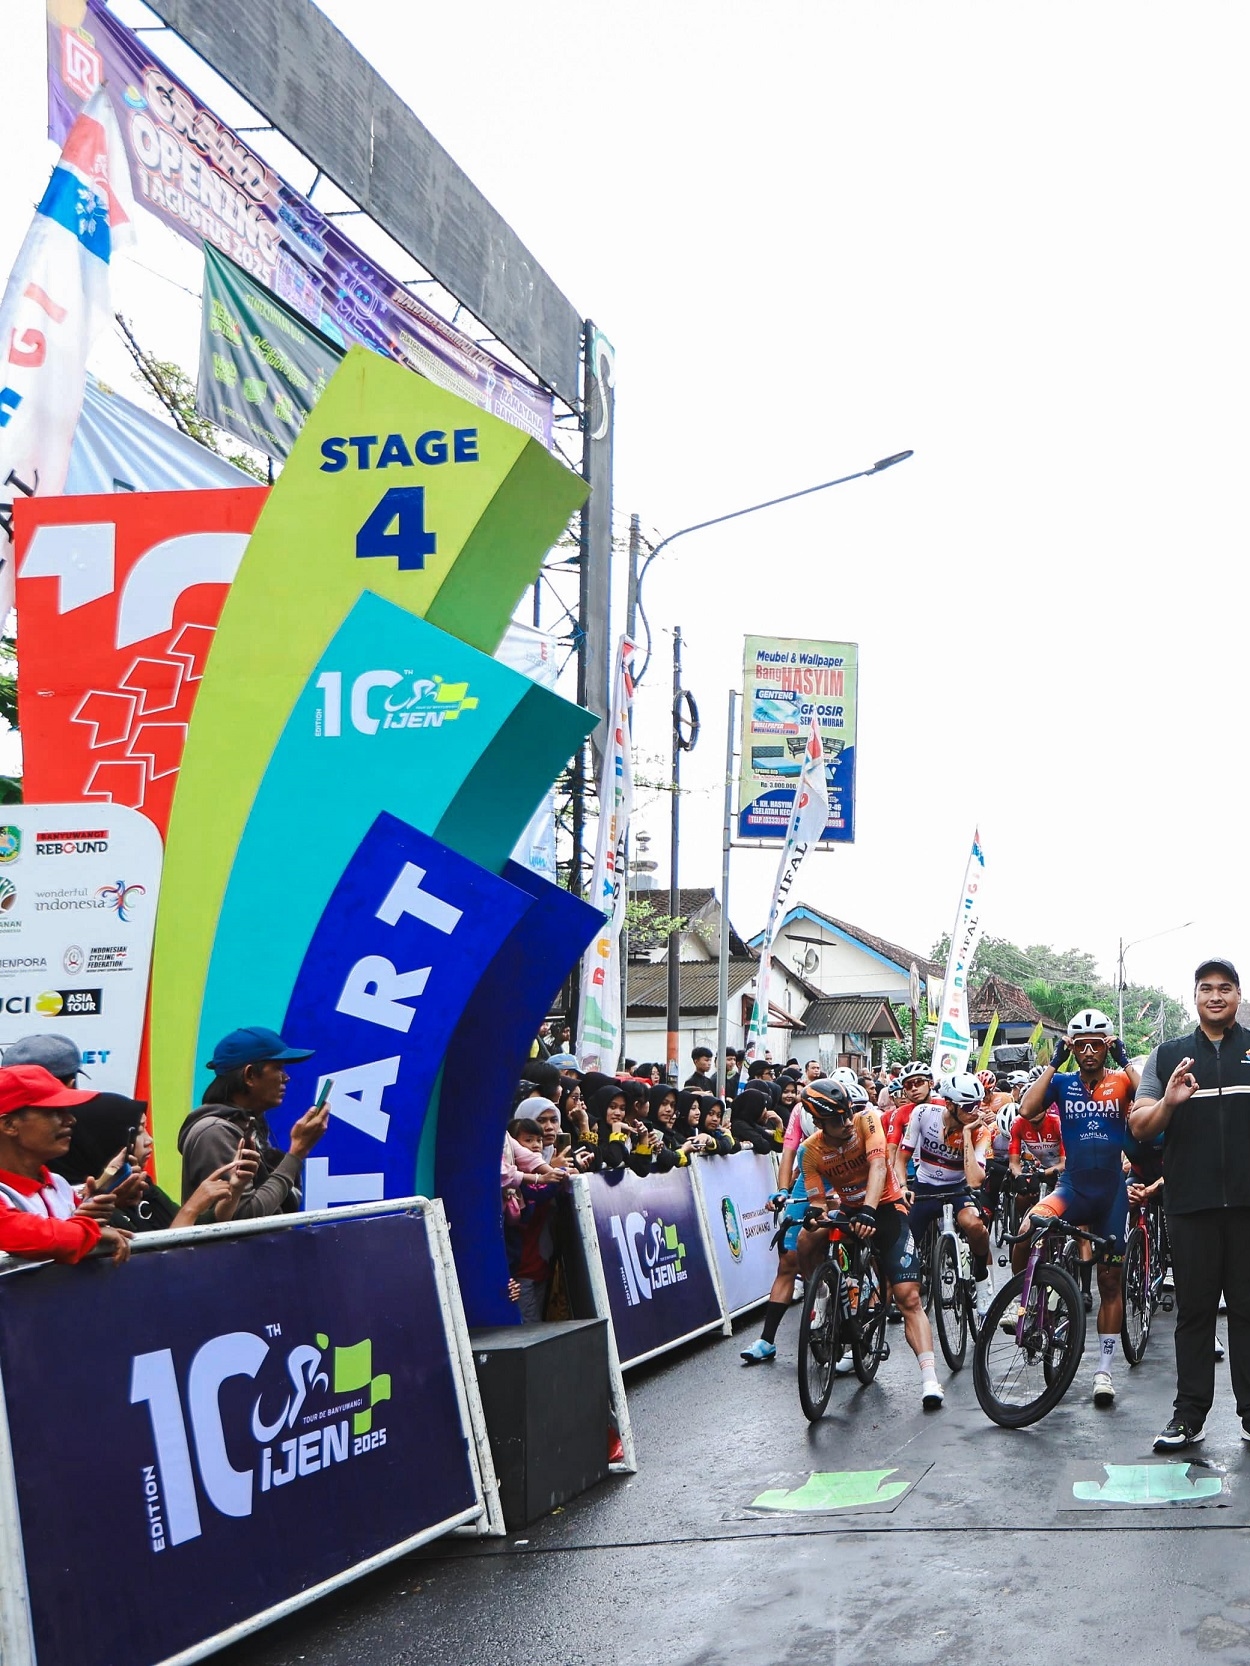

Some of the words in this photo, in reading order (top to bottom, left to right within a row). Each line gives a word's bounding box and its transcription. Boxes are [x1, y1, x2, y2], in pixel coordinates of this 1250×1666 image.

[131, 112, 280, 267] OPENING
[151, 177, 230, 251] AGUSTUS
[232, 236, 271, 283] 2025
[501, 388, 545, 432] RAMAYANA
[320, 428, 479, 473] STAGE
[355, 486, 437, 571] 4
[756, 650, 789, 663] Meubel
[790, 652, 797, 663] &
[799, 653, 843, 668] Wallpaper
[756, 664, 782, 682] Bang
[781, 667, 844, 697] HASYIM
[758, 690, 794, 700] GENTENG
[315, 708, 323, 737] EDITION
[822, 717, 844, 728] MURAH
[40, 830, 105, 840] BANYUWANGI
[36, 841, 108, 855] REBOUND
[35, 888, 88, 898] wonderful
[35, 898, 107, 911] indonesia
[91, 945, 128, 953] INDONESIAN
[66, 1002, 96, 1012] TOUR
[67, 993, 94, 1003] ASIA
[1065, 1098, 1120, 1113] ROOJAI
[923, 1137, 961, 1156] ROOJA
[265, 1323, 282, 1338] TH
[303, 1413, 318, 1425] TOUR
[319, 1410, 327, 1419] DE
[327, 1399, 363, 1417] BANYUWANGI
[354, 1428, 387, 1456] 2025
[144, 1465, 167, 1553] EDITION
